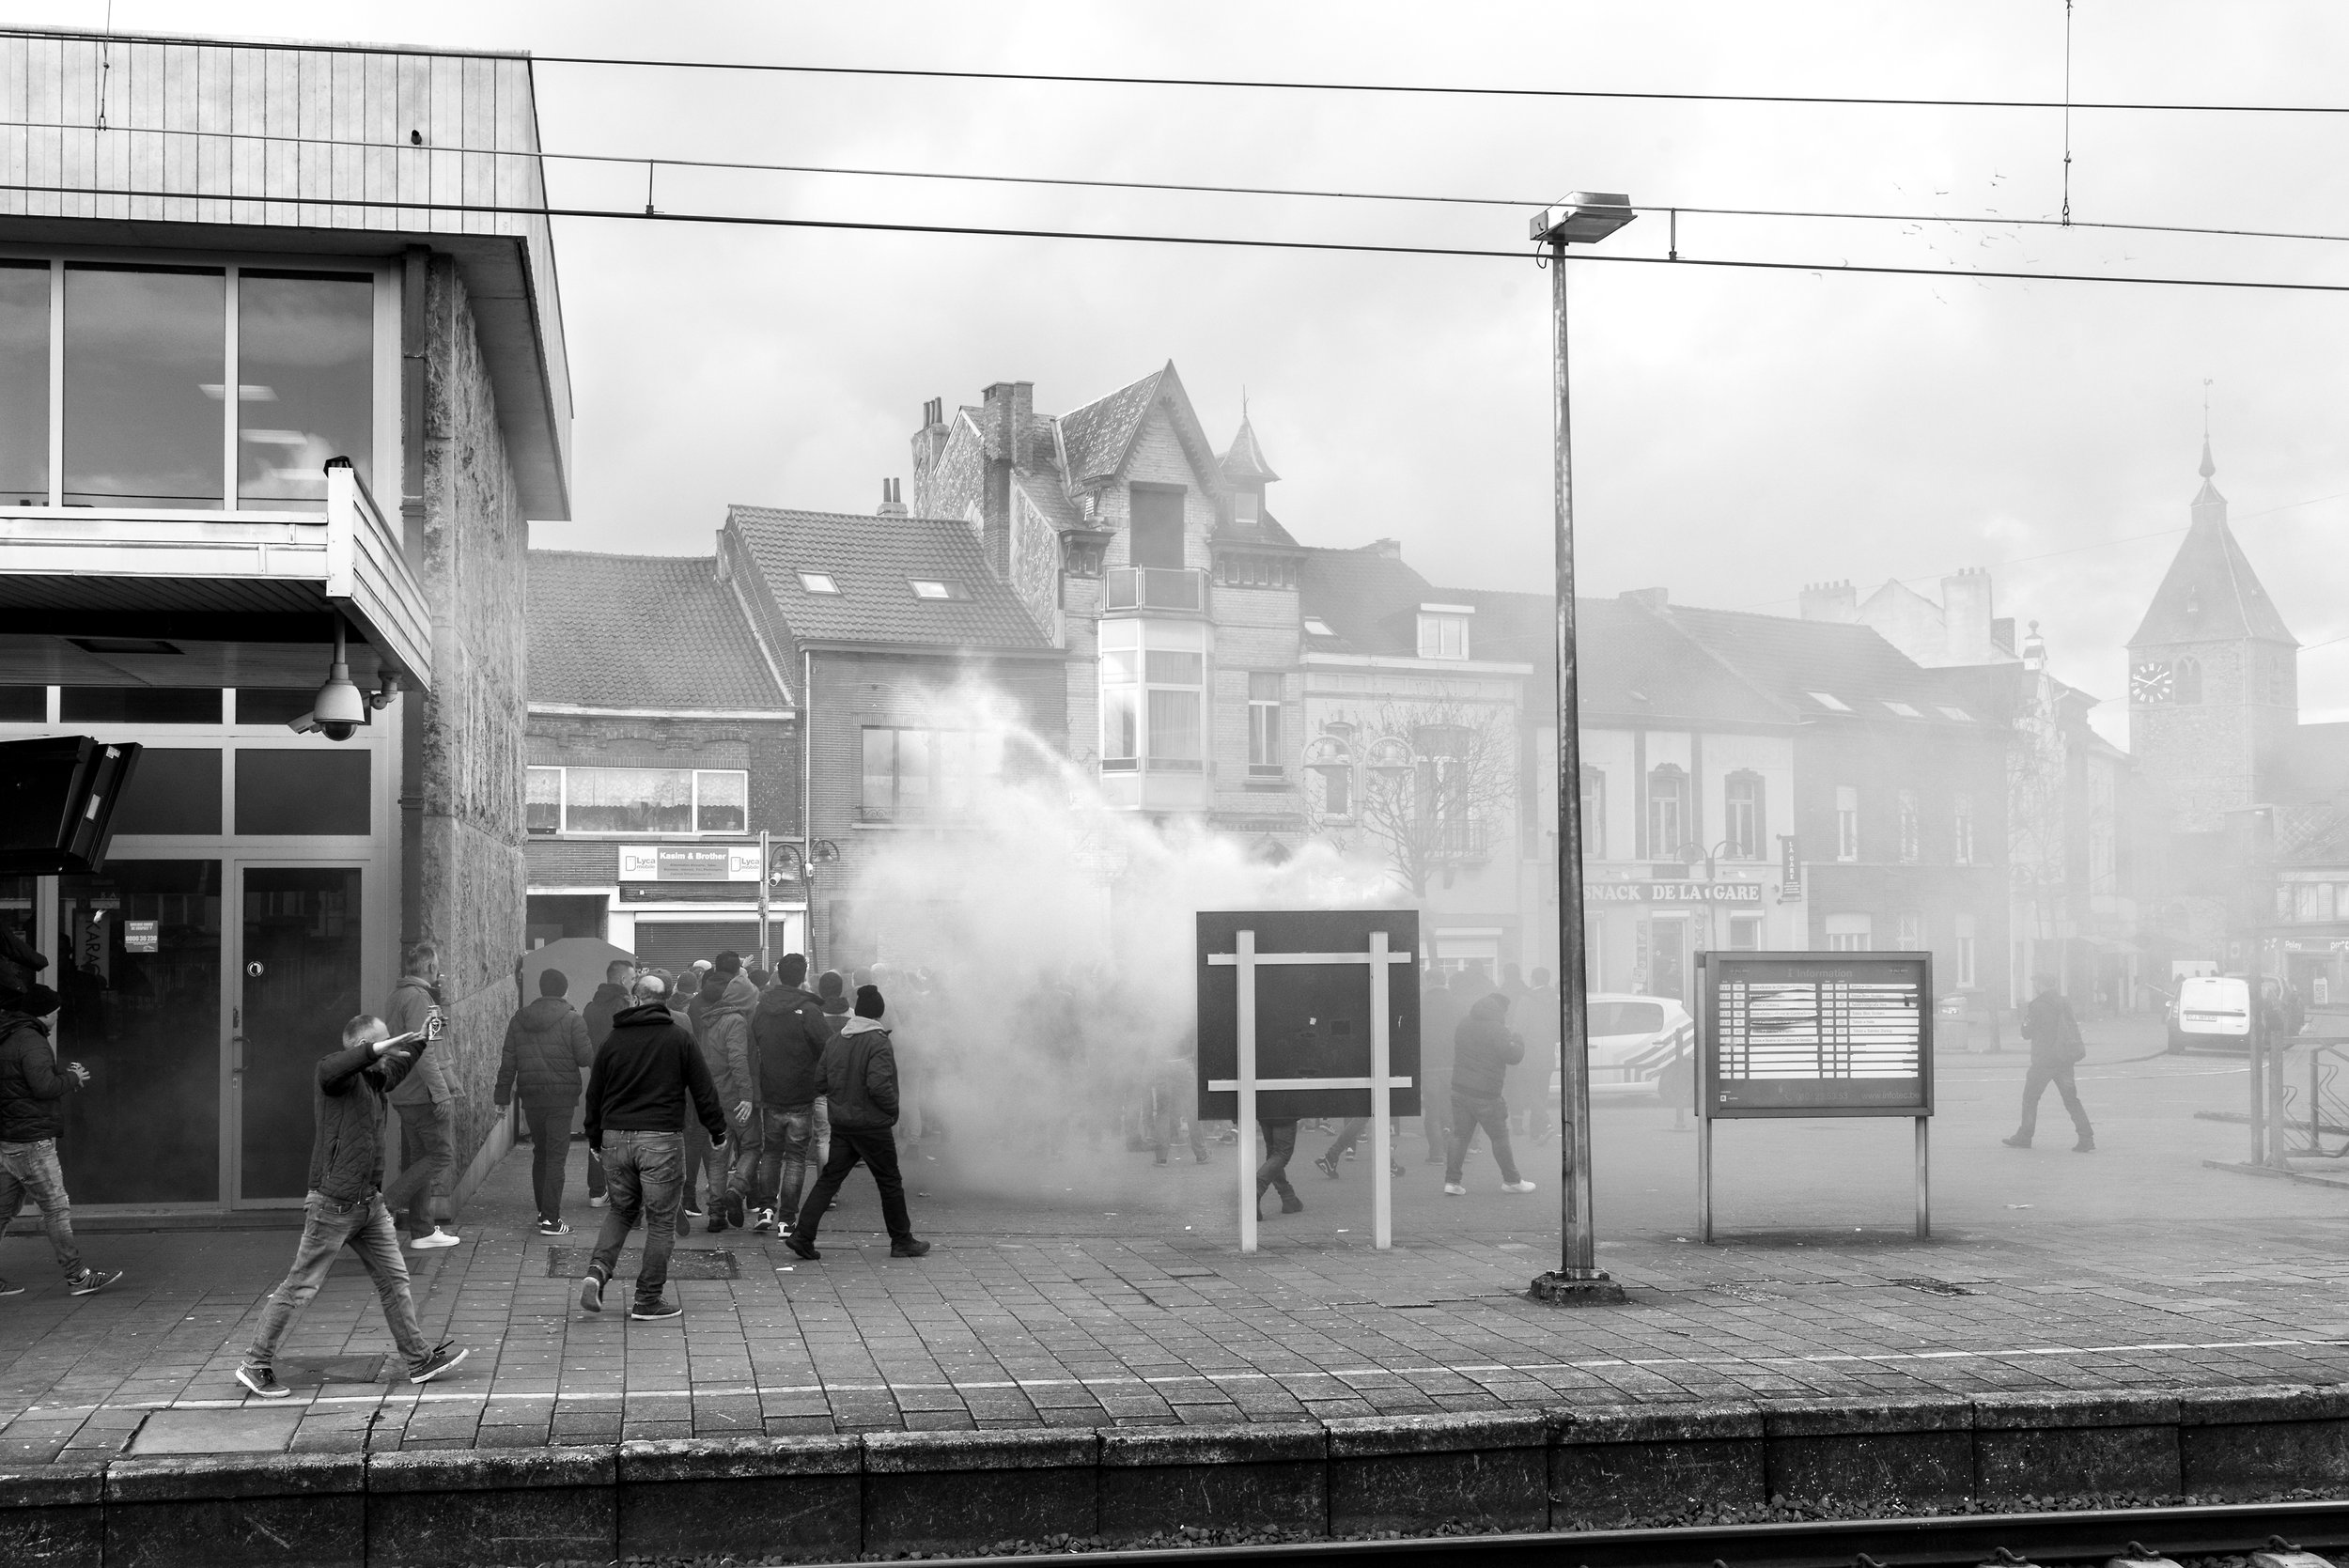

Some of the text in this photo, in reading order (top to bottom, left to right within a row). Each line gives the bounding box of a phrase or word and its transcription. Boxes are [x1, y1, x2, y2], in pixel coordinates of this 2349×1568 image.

[637, 857, 656, 865] Lyca
[741, 857, 760, 865] Lyca
[1583, 885, 1759, 900] SNACK DE LA GARE
[1797, 969, 1853, 978] Information
